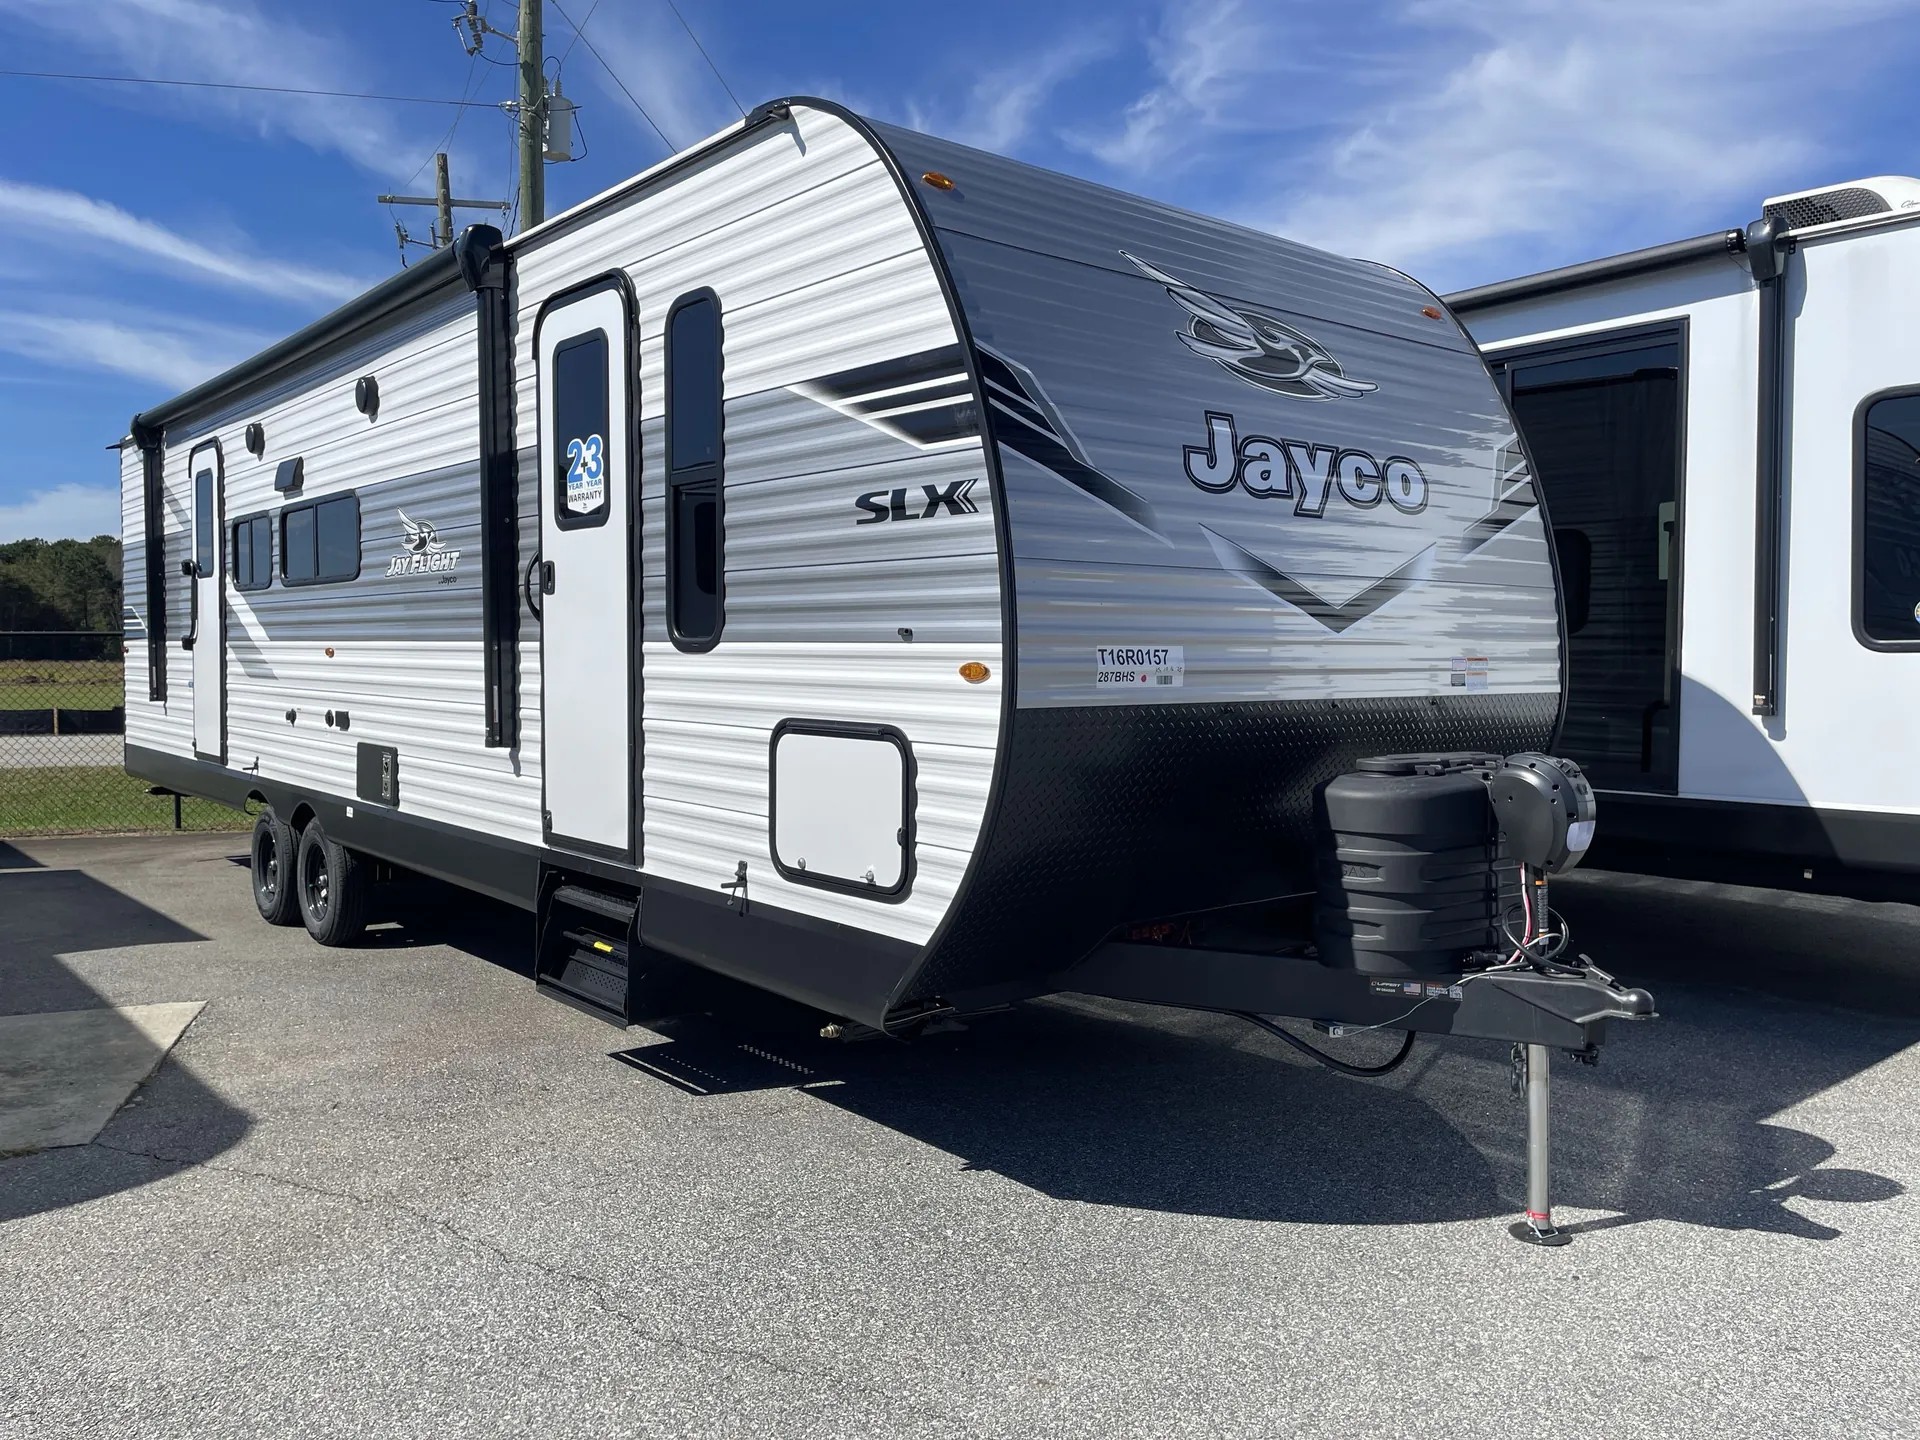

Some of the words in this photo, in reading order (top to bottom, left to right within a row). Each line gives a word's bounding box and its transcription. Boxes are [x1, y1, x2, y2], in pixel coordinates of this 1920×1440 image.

[1182, 410, 1429, 519] Jayco
[568, 482, 583, 491] YEAR
[586, 479, 602, 488] YEAR
[568, 490, 602, 503] WARRANTY
[855, 478, 979, 525] SLX
[385, 556, 410, 578] JAY
[408, 550, 461, 574] FLIGHT
[1098, 649, 1168, 665] T16R0157
[1098, 671, 1135, 683] 287BHS
